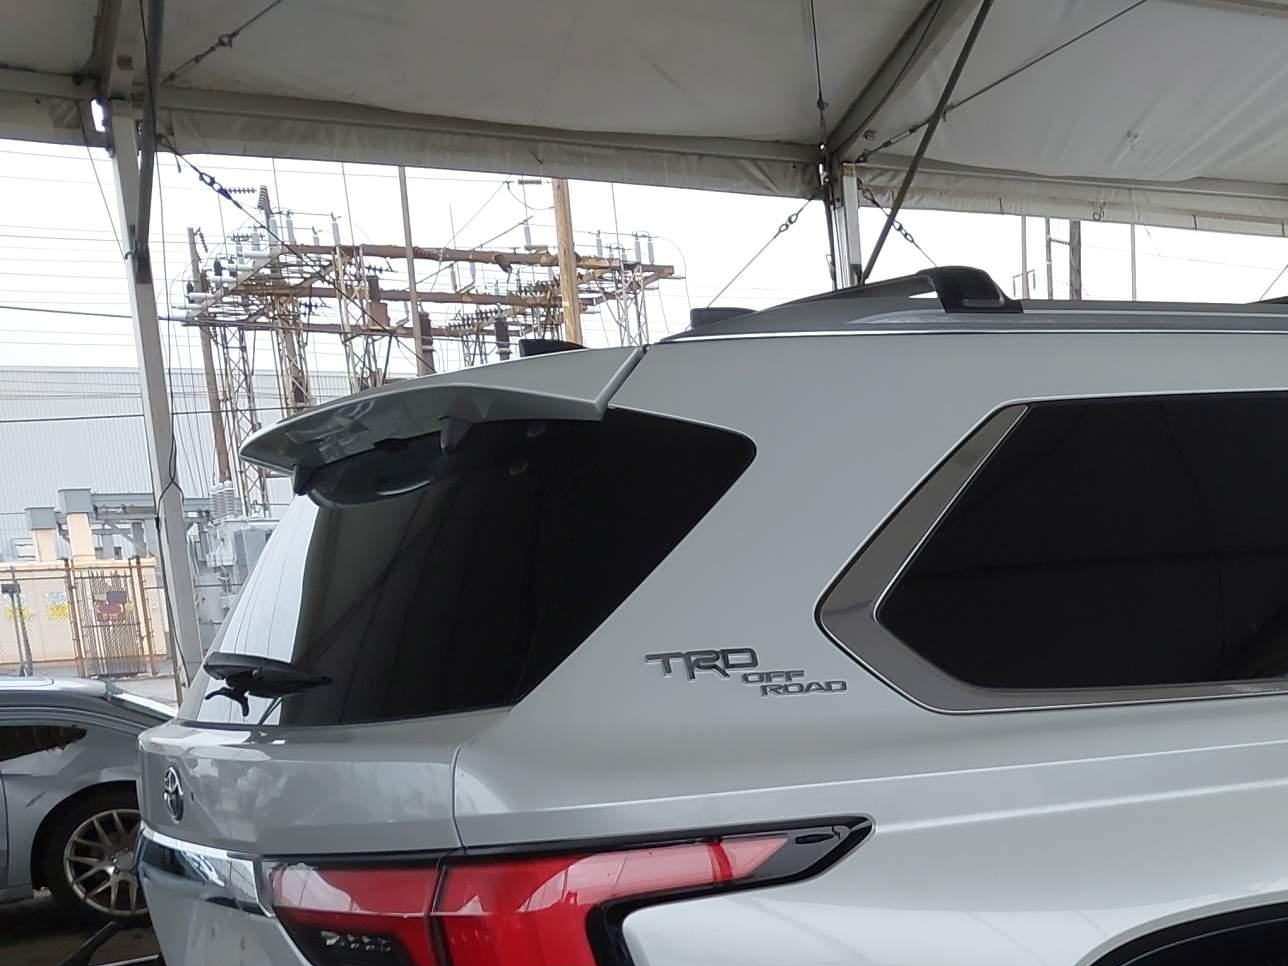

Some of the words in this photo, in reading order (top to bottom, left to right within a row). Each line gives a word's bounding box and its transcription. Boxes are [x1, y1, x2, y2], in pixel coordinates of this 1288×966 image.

[645, 648, 759, 681] TRD
[742, 670, 805, 684] OFF
[760, 680, 848, 697] ROAD
